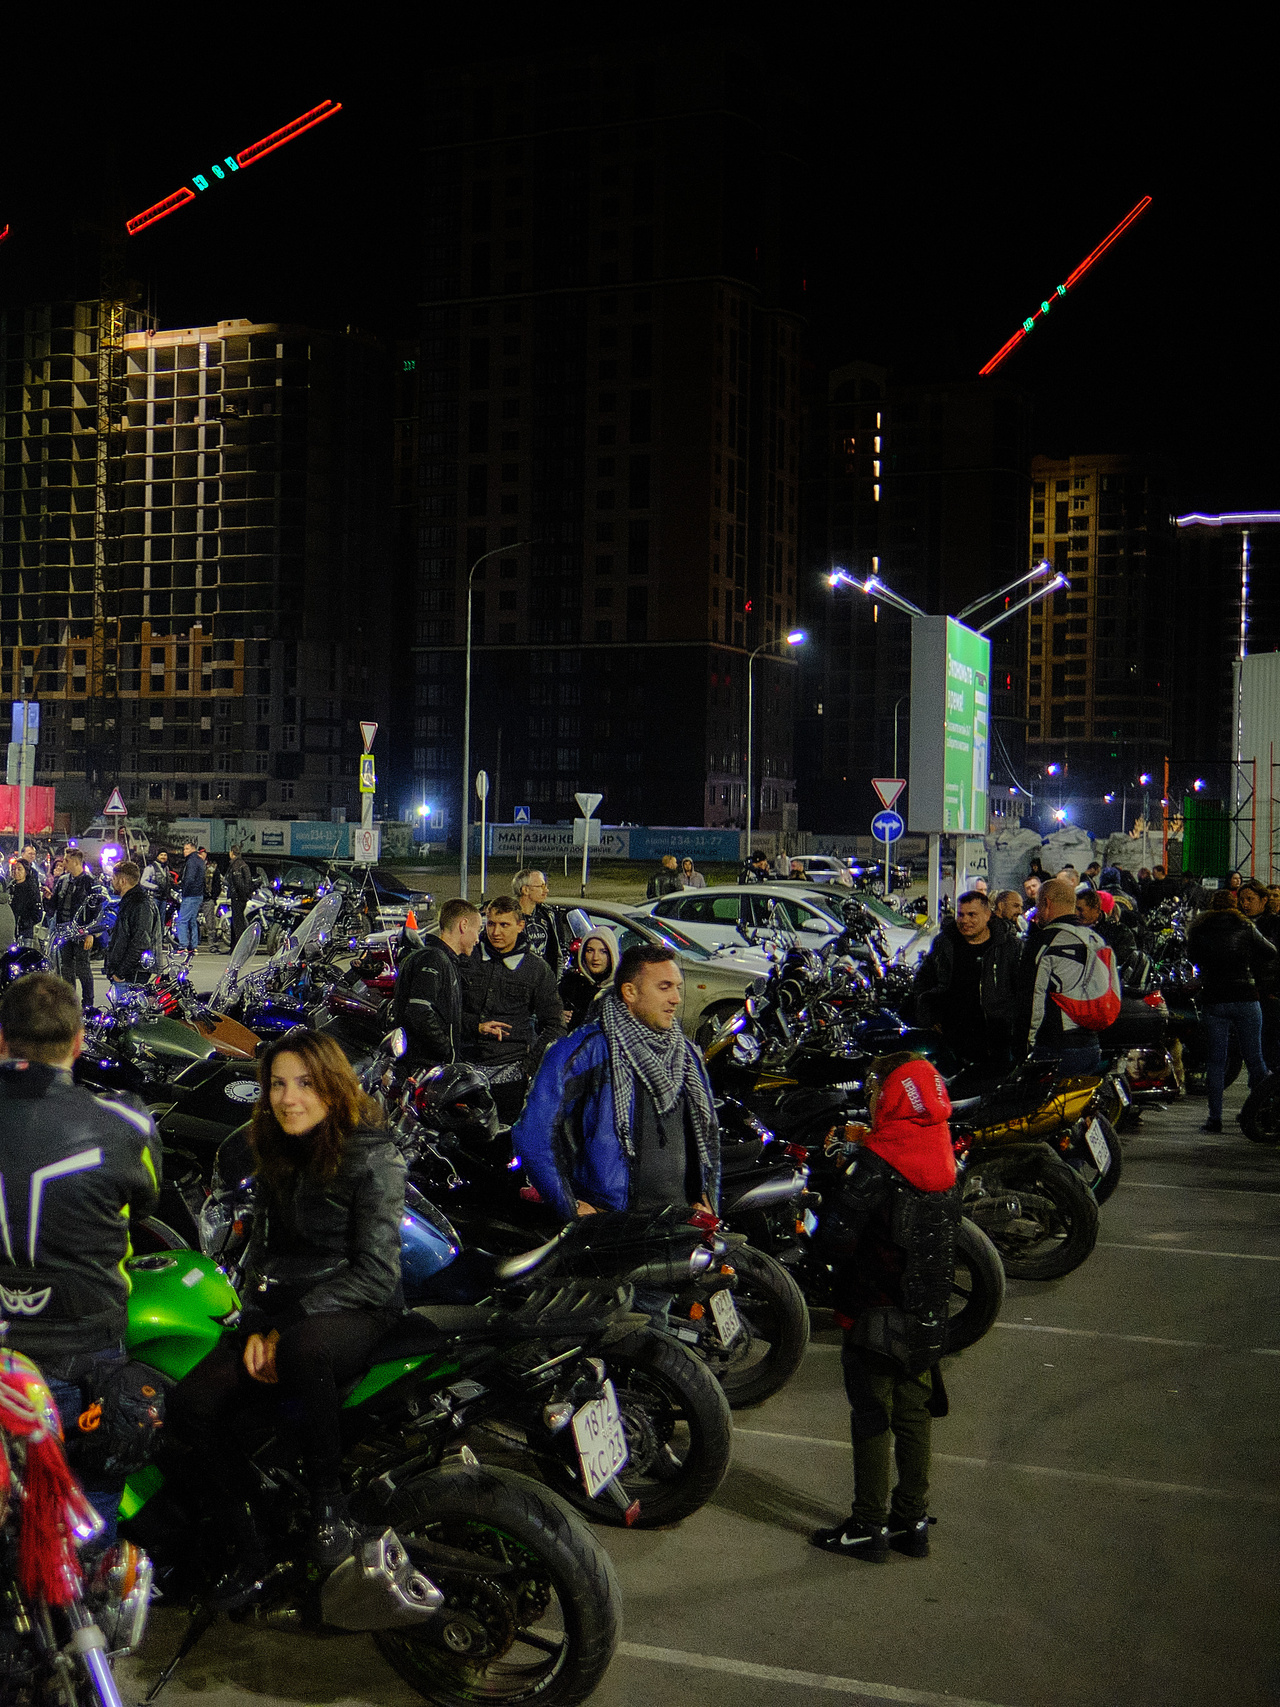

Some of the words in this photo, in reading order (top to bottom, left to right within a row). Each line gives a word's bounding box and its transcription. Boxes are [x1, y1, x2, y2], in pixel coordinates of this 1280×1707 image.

[498, 832, 556, 843] МАГАЗИН
[558, 834, 614, 845] КВИР
[608, 1430, 623, 1465] 23
